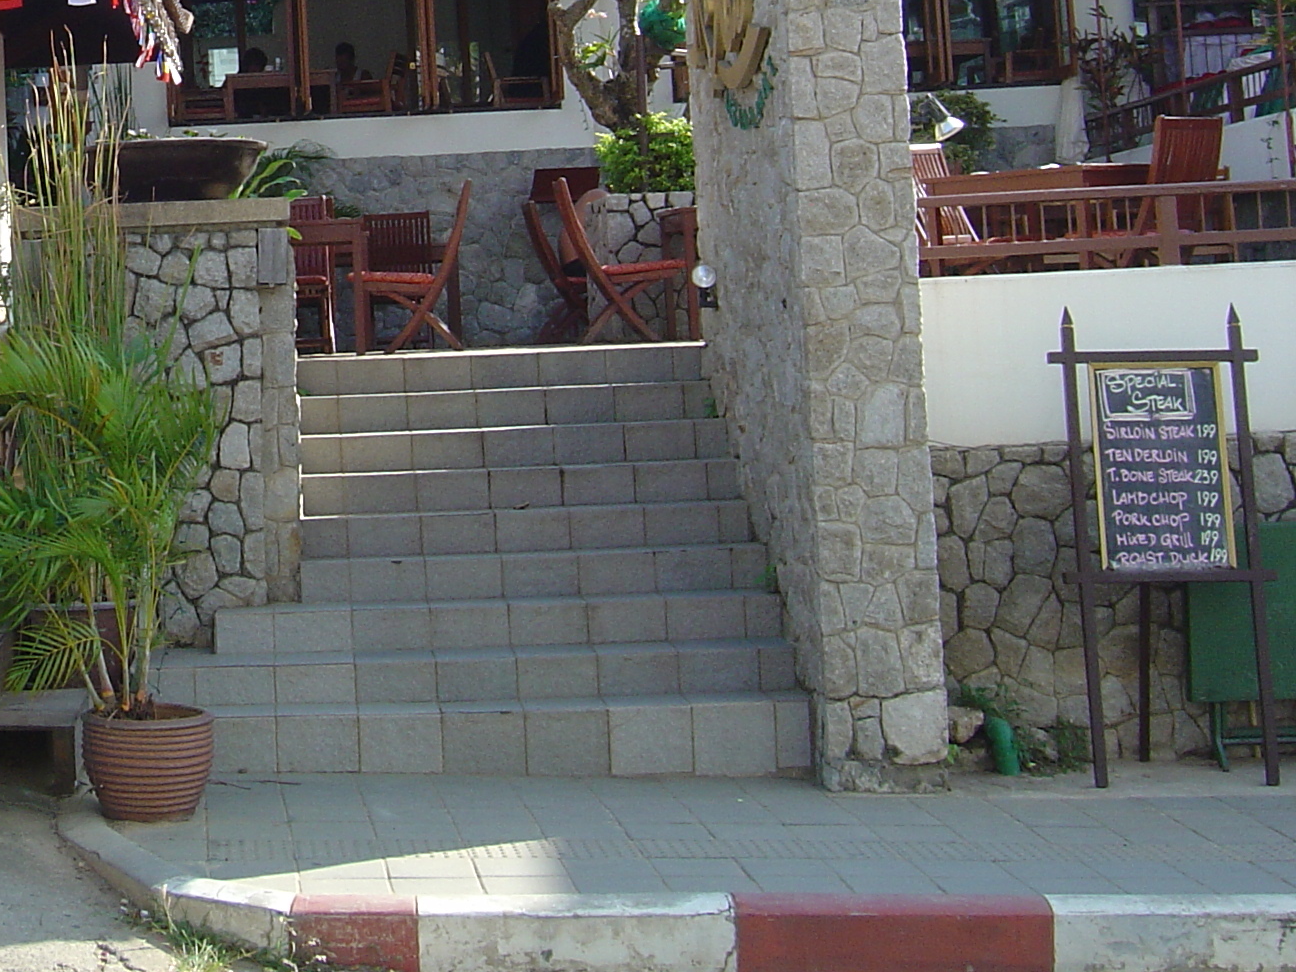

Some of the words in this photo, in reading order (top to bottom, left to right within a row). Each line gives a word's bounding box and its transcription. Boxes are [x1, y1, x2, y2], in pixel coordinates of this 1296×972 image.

[1127, 391, 1184, 413] STEAK
[1104, 422, 1156, 440] SIRLOIN
[1159, 425, 1195, 440] STEAK
[1196, 424, 1216, 439] 199
[1198, 449, 1218, 466] 199
[1194, 469, 1219, 485] 239
[1150, 491, 1188, 510] CHOP
[1197, 491, 1219, 507] 199
[1111, 510, 1152, 526] PORK
[1152, 512, 1190, 532] CHOP
[1200, 512, 1221, 527] 199
[1115, 551, 1164, 566] ROAST
[1169, 550, 1209, 565] DUCK
[1210, 548, 1228, 564] 199
